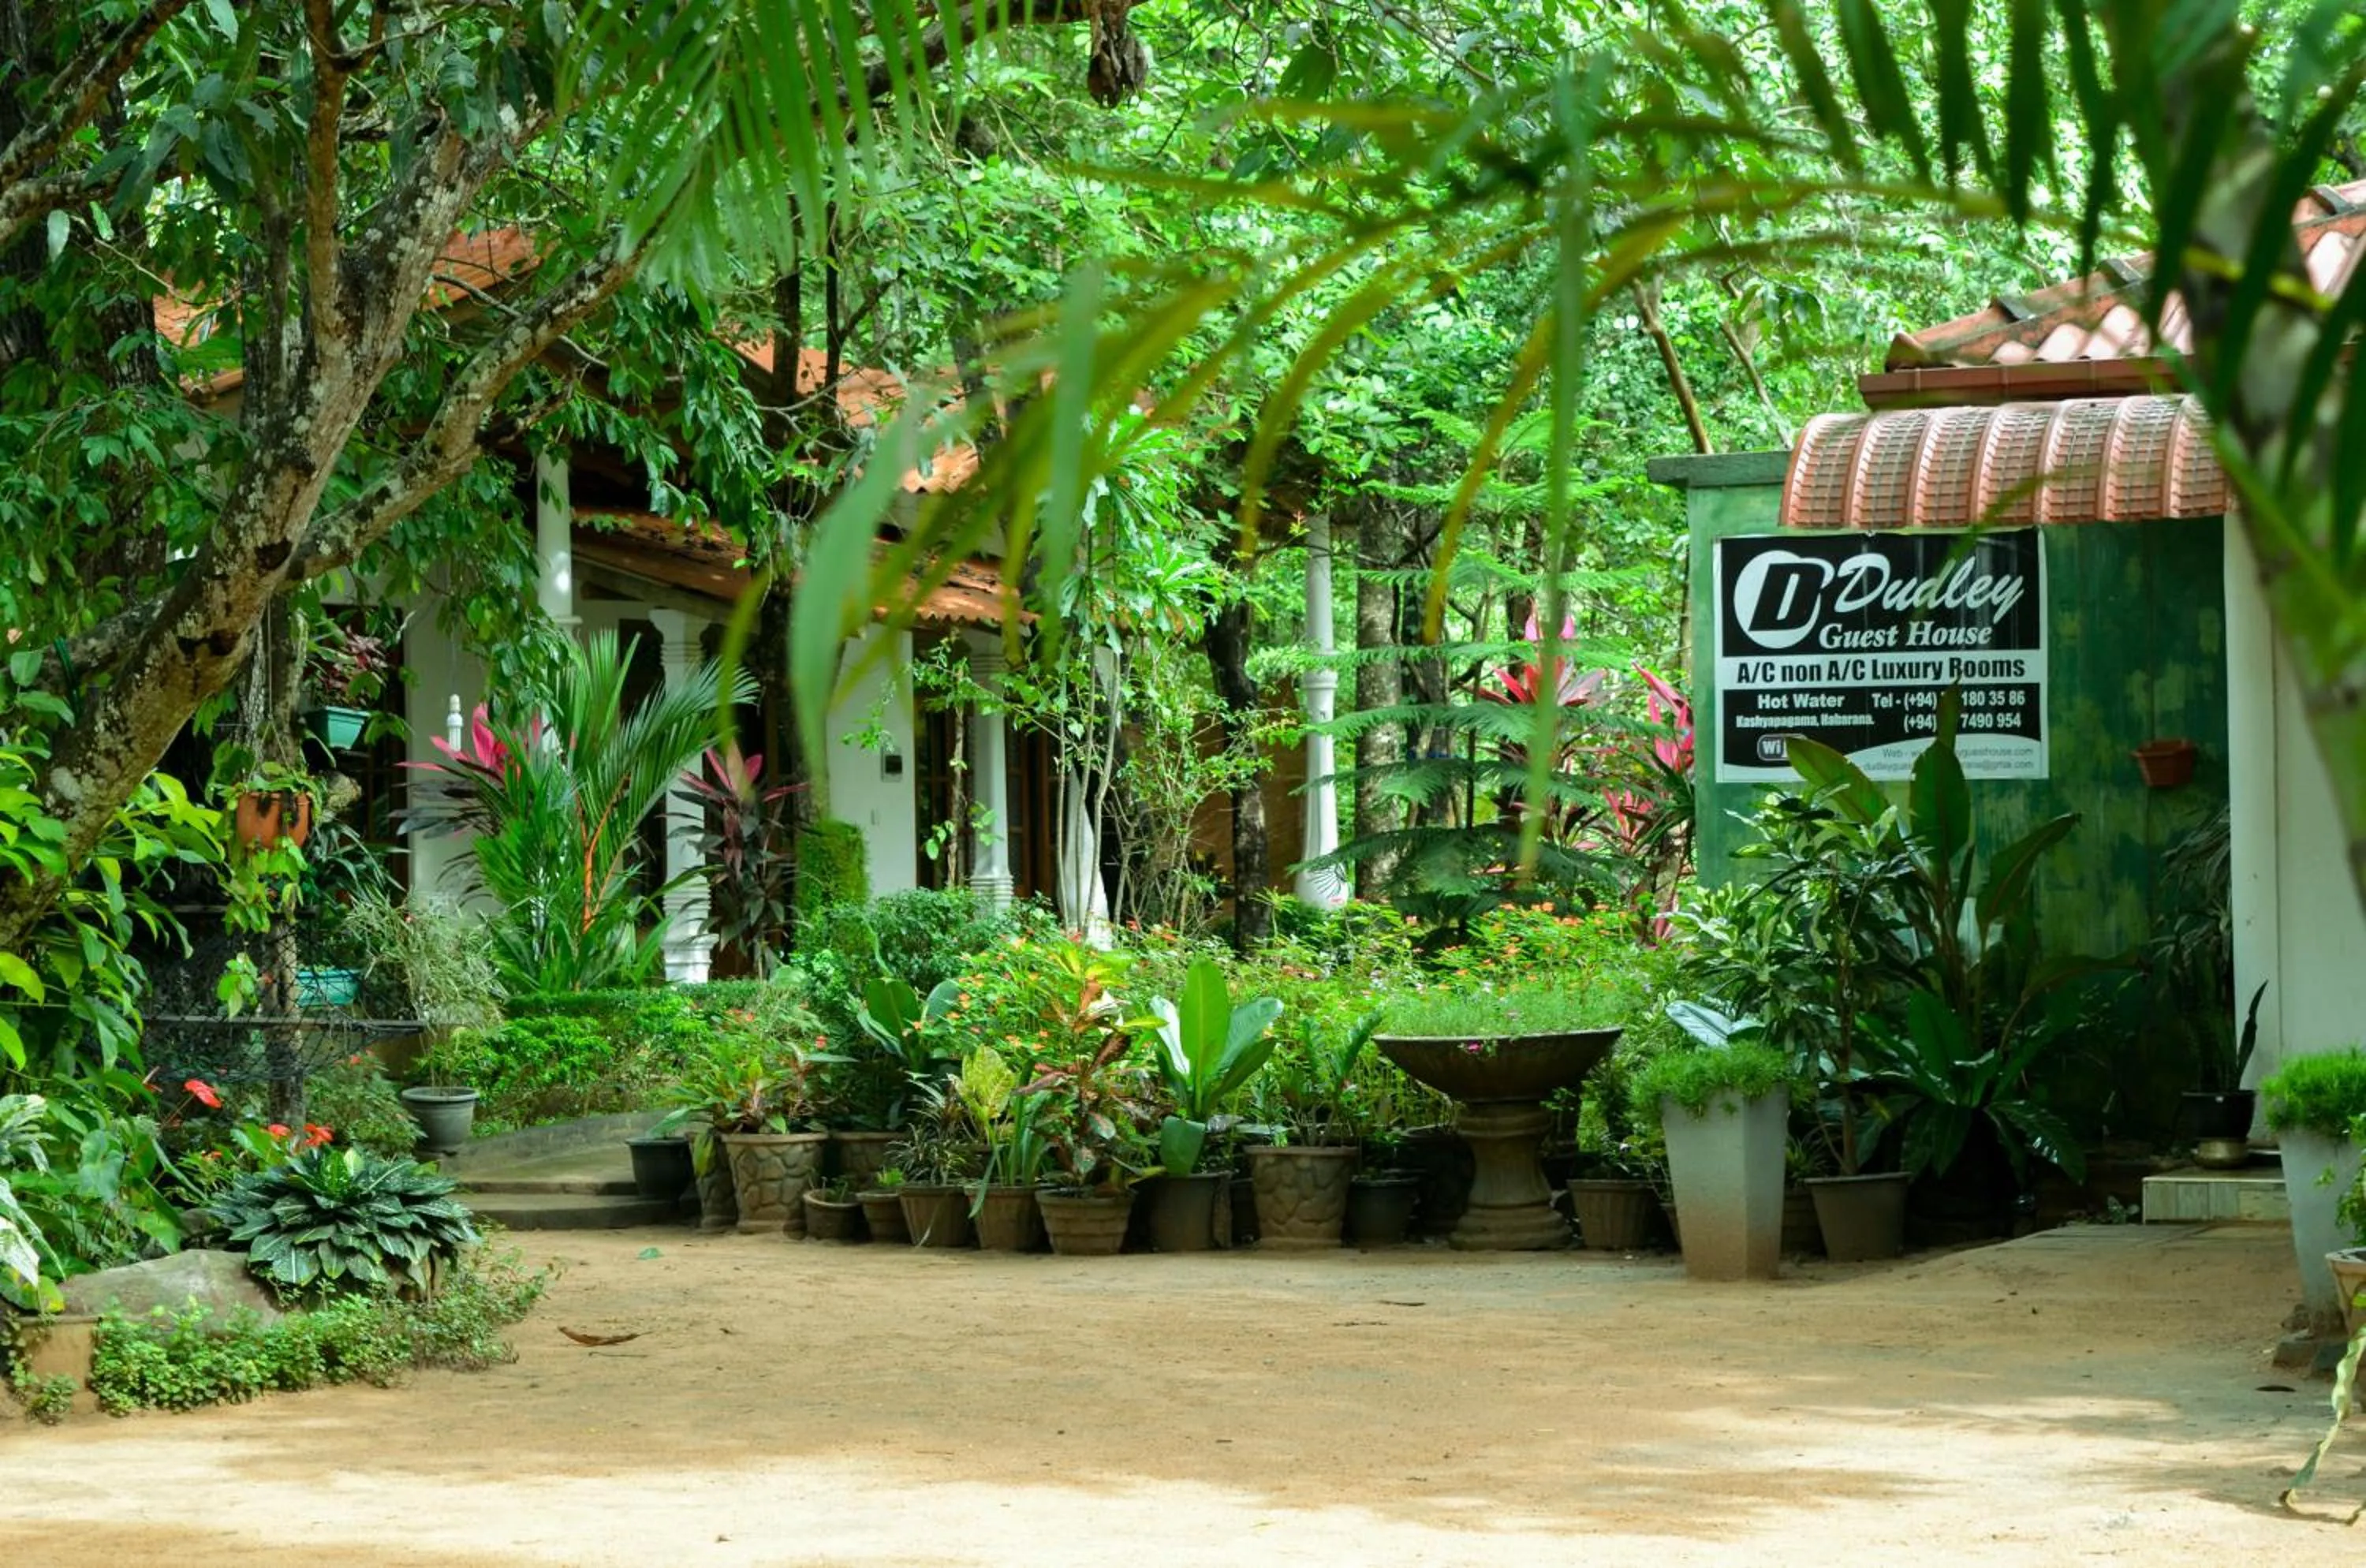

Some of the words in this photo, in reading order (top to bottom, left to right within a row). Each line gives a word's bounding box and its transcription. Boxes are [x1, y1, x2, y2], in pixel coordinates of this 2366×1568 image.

[1834, 553, 2025, 624] Dudley
[1819, 623, 1898, 649] Guest
[1905, 621, 1992, 645] House
[1737, 662, 1775, 684] A/C
[1781, 663, 1822, 682] non
[1827, 659, 1865, 681] A/C
[1872, 659, 1943, 681] Luxury
[1949, 657, 2025, 678] Rooms
[1757, 694, 1789, 709] Hot
[1793, 693, 1845, 708] Water
[1872, 693, 1893, 708] Tel
[1904, 692, 1938, 711] (+94)
[1961, 691, 1986, 707] 180
[1988, 691, 2006, 706] 35
[2009, 690, 2026, 706] 86
[1903, 714, 1937, 733] (+94)
[1961, 713, 1994, 729] 7490
[1996, 713, 2022, 727] 954
